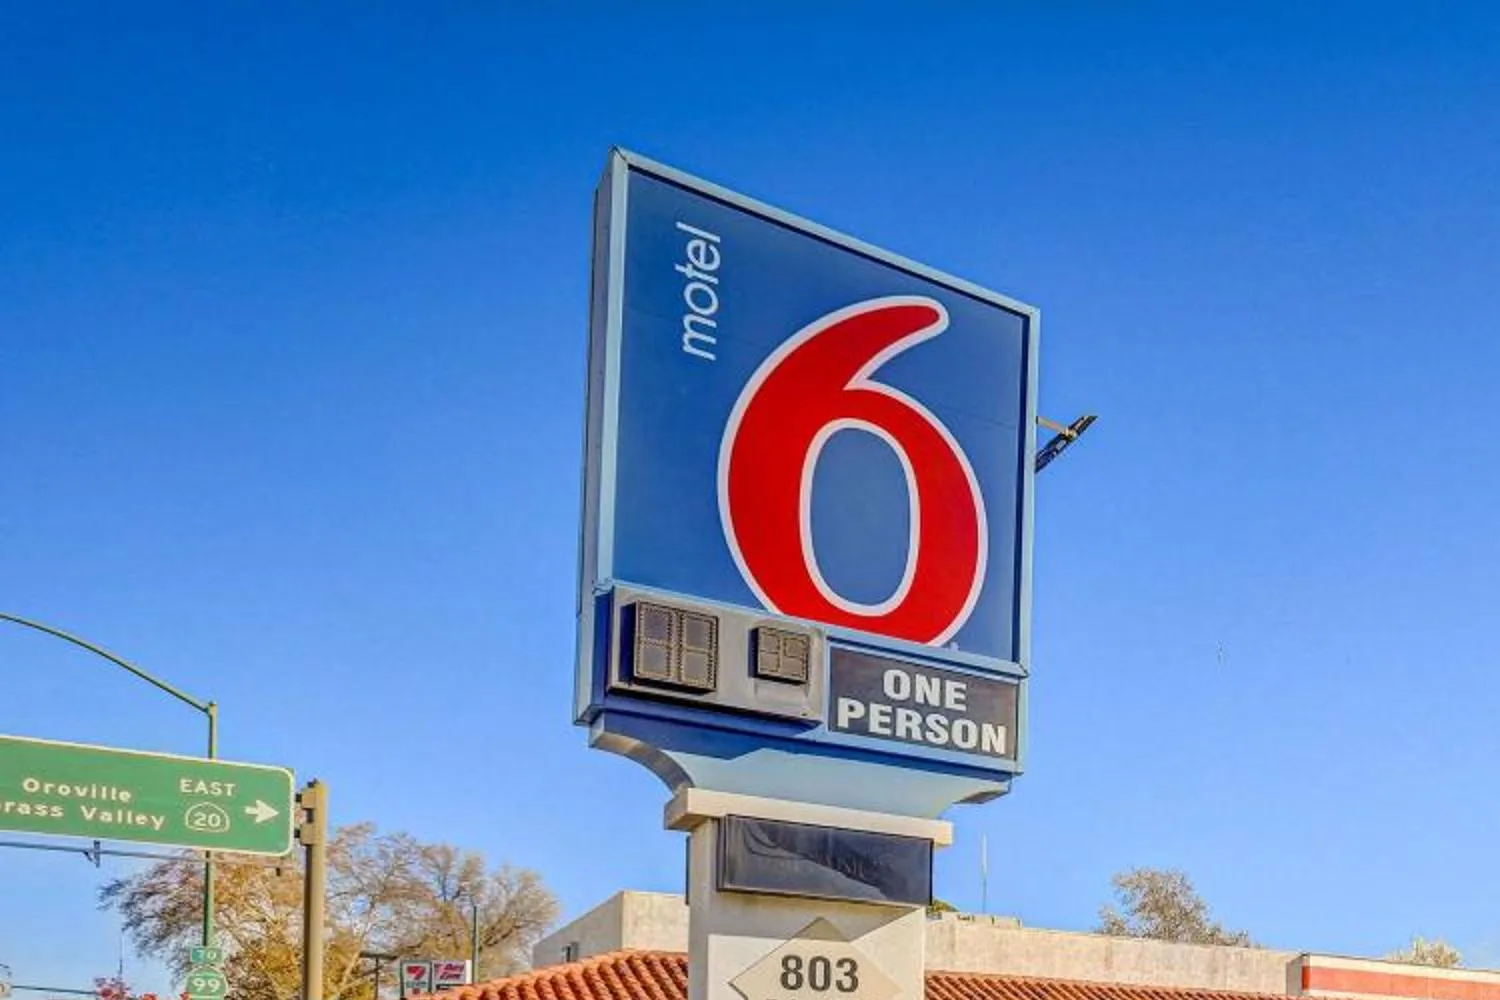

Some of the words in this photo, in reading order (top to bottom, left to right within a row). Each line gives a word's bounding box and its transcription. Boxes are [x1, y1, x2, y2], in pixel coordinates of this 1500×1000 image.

[674, 221, 721, 361] motel
[717, 295, 988, 647] 6
[883, 669, 967, 712] ONE
[837, 697, 1007, 755] PERSON
[22, 777, 132, 802] Oroville
[180, 779, 236, 797] EAST
[0, 799, 64, 818] rass
[80, 804, 165, 831] Valley
[193, 812, 221, 827] 20
[192, 977, 221, 992] 99
[780, 954, 859, 993] 803
